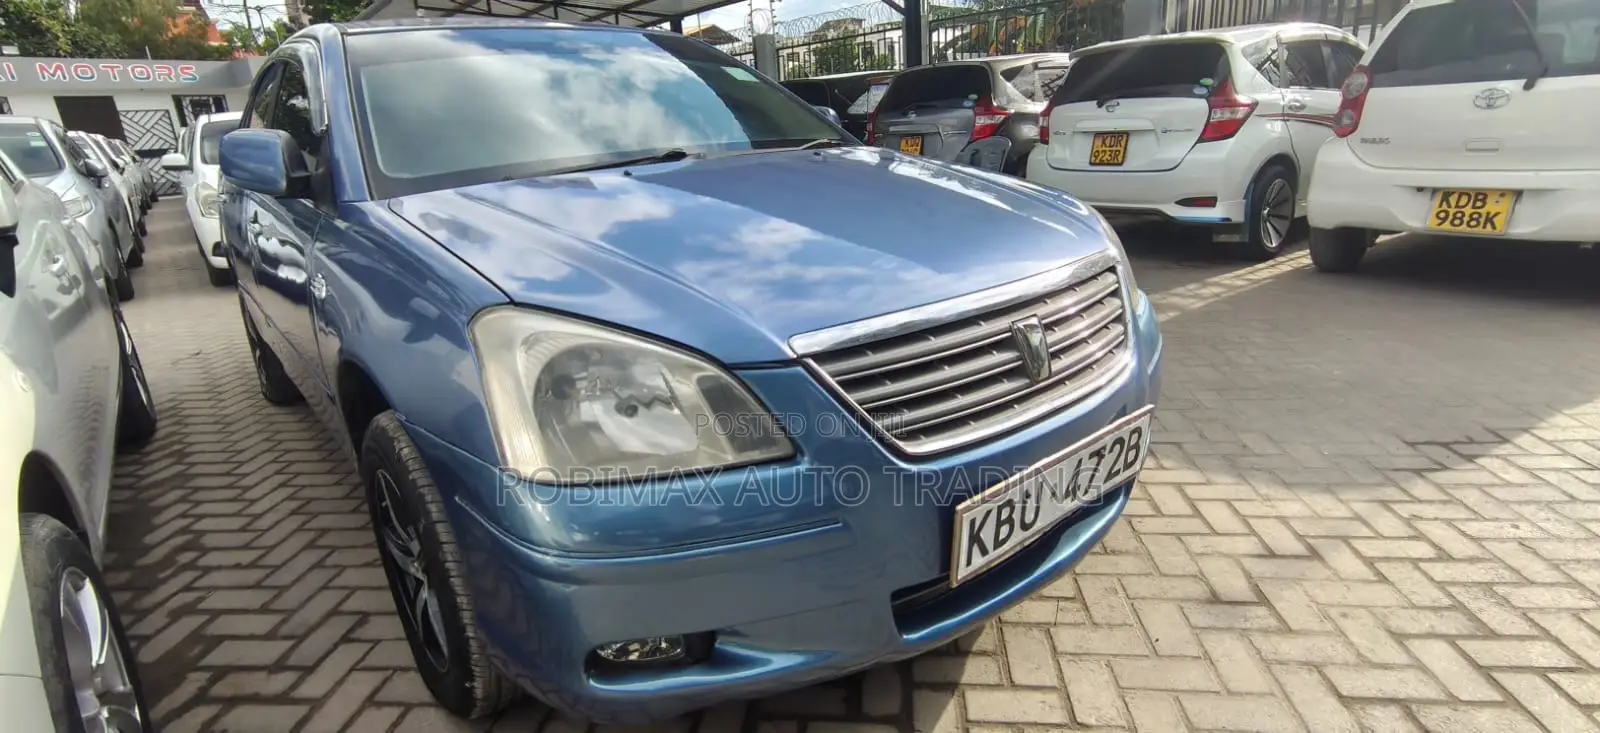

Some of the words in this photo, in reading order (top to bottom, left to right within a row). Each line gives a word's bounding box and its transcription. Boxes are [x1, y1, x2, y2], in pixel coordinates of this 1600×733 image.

[0, 62, 17, 81] I
[36, 62, 200, 83] MOTORS
[1100, 134, 1124, 148] KDR
[1092, 149, 1122, 163] 923R
[1438, 190, 1489, 210] KDB
[1435, 209, 1502, 231] 988K
[966, 479, 1044, 568] KBU
[1063, 426, 1143, 502] 472B
